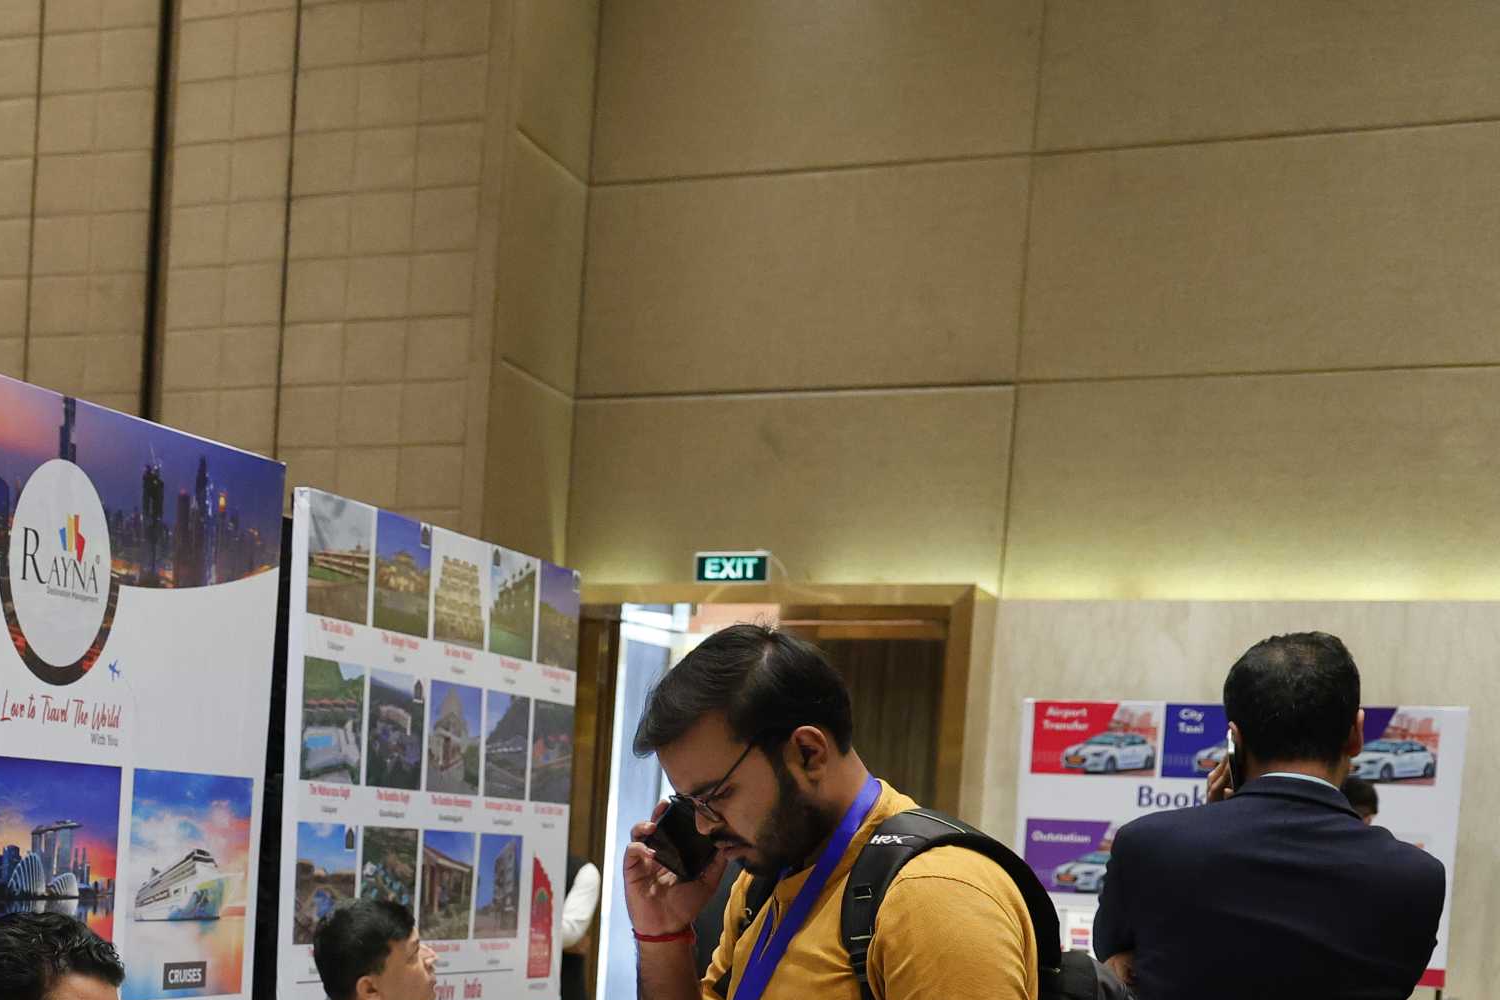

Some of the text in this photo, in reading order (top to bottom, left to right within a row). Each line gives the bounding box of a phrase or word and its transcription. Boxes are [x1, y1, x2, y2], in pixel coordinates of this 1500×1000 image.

[20, 526, 98, 595] RAYNA
[704, 557, 758, 579] EXIT
[1046, 704, 1088, 719] Airport
[1178, 707, 1204, 721] City
[1042, 719, 1089, 731] Transfer
[870, 834, 915, 845] HRX
[168, 967, 203, 985] CRUISES
